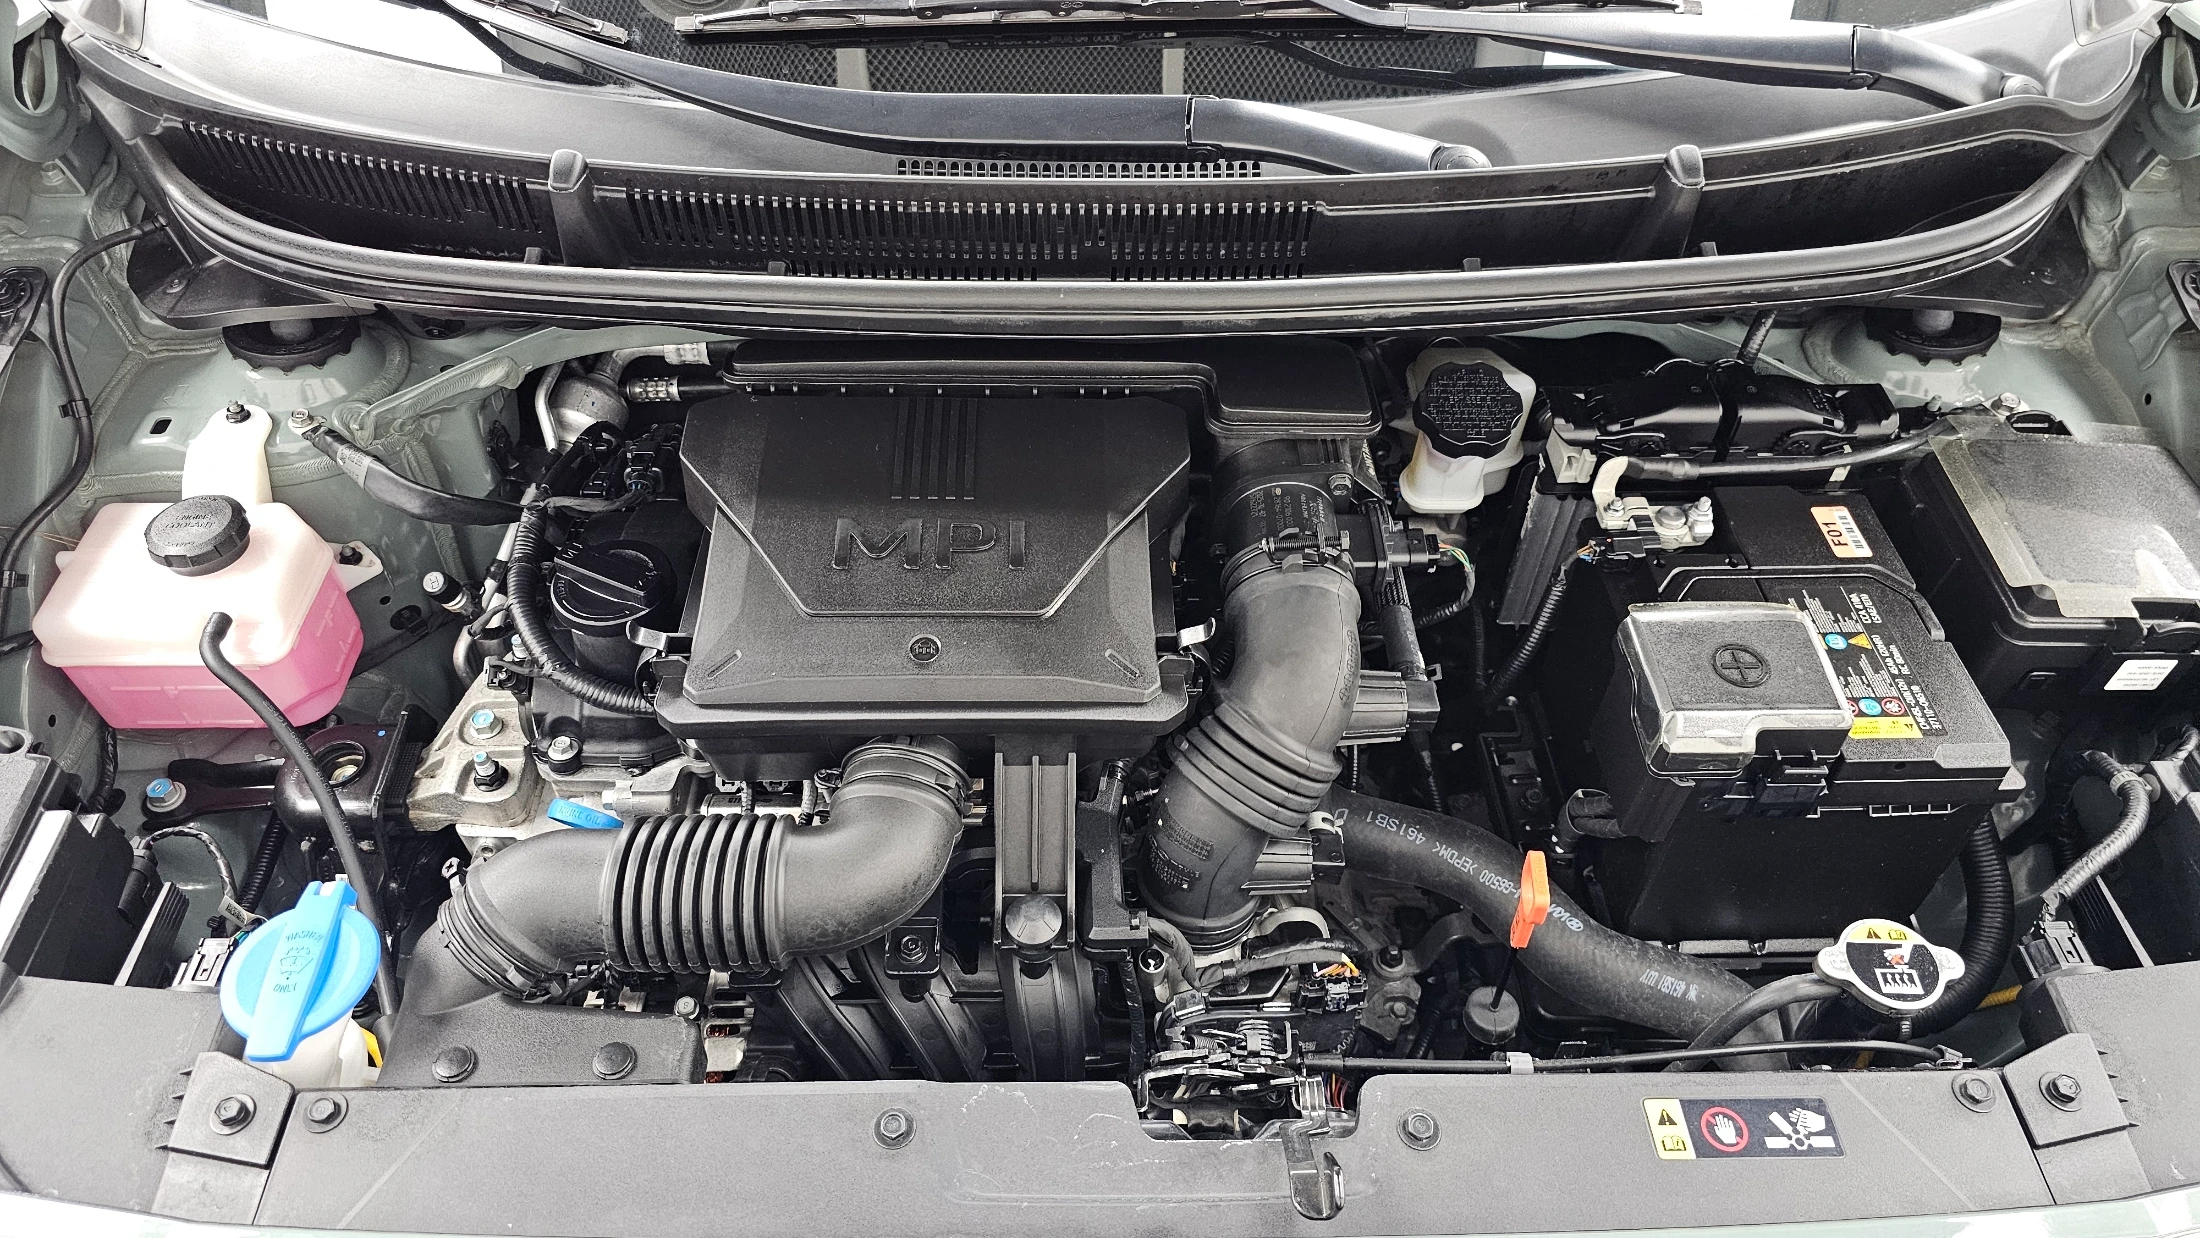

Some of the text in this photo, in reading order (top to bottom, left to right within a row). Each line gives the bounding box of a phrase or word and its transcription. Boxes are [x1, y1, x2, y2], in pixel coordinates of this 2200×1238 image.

[832, 517, 1025, 570] MPI
[1857, 607, 1872, 624] CCA
[1366, 810, 1426, 845] 461SB1
[273, 982, 298, 993] ONLY
